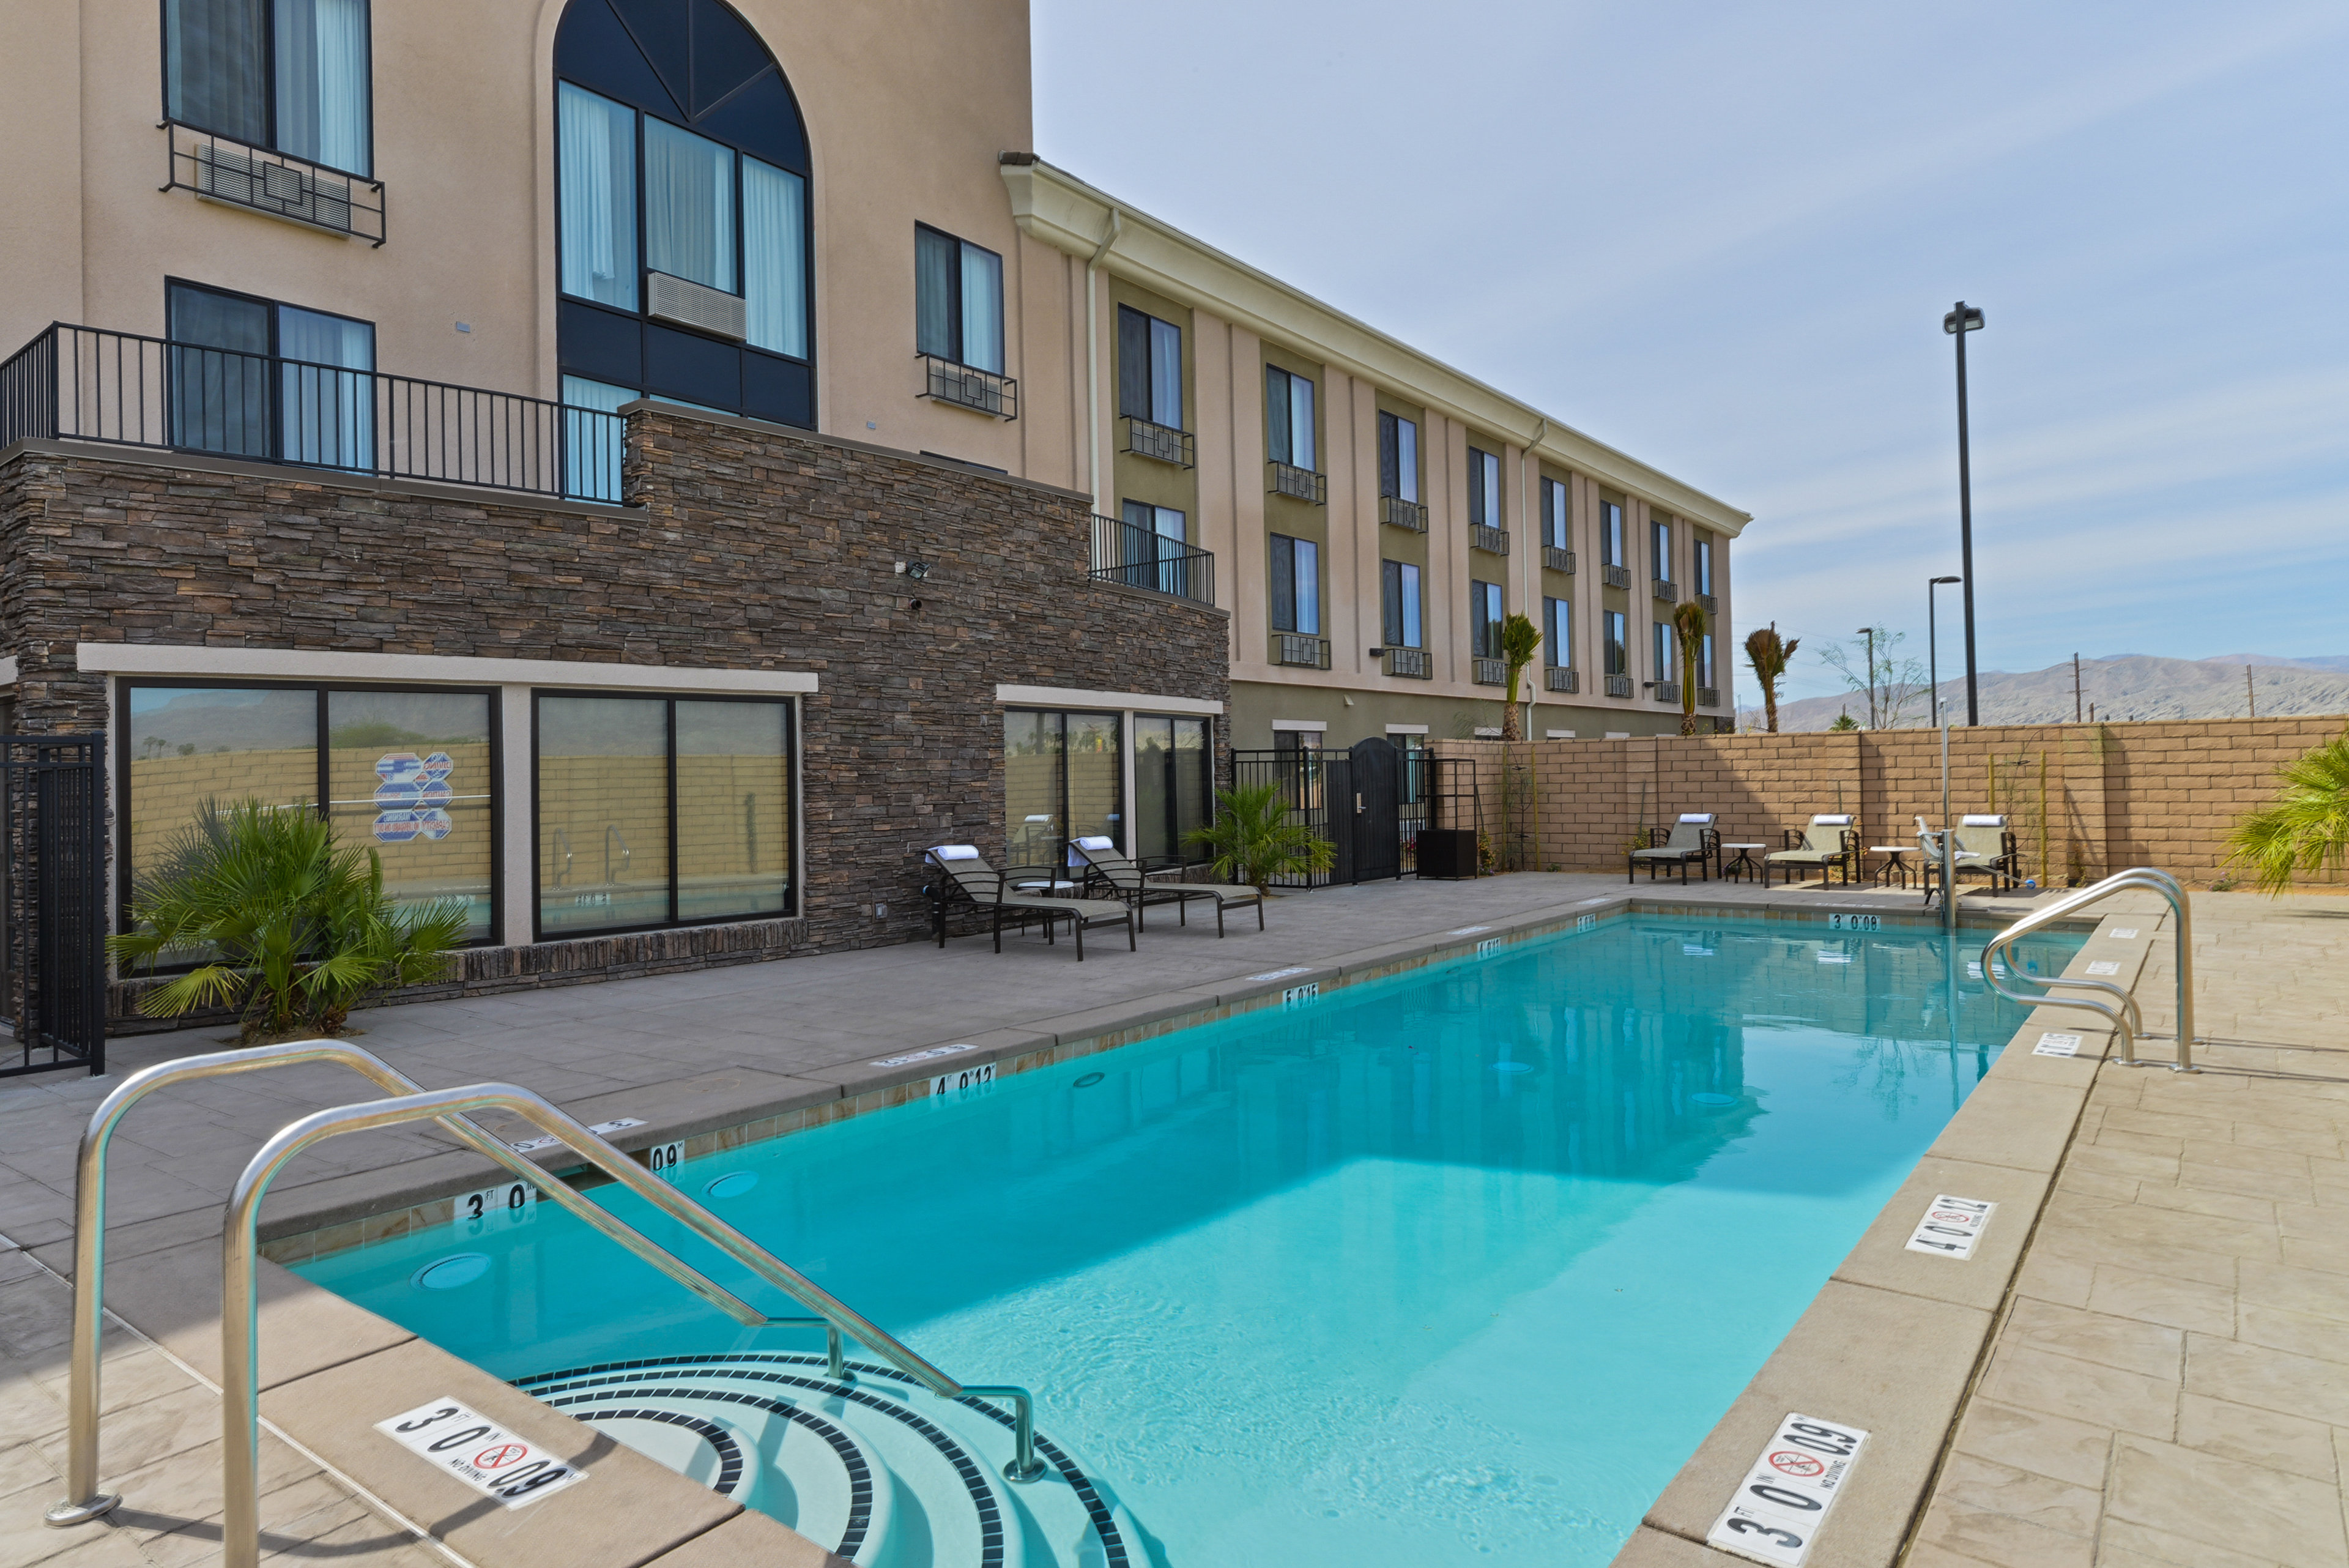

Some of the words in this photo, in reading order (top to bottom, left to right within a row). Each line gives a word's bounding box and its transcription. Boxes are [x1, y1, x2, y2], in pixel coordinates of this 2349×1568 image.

[936, 1076, 946, 1096] 4
[959, 1072, 969, 1090] 0
[467, 1194, 484, 1220] 3
[509, 1184, 525, 1209] 0
[395, 1406, 461, 1433] 3
[426, 1425, 492, 1452] 0
[447, 1457, 465, 1468] NO
[458, 1462, 488, 1482] DIVING
[1825, 1460, 1847, 1481] DIVING
[1749, 1484, 1823, 1512] 0
[1819, 1479, 1836, 1491] NO
[1726, 1517, 1803, 1549] 3
